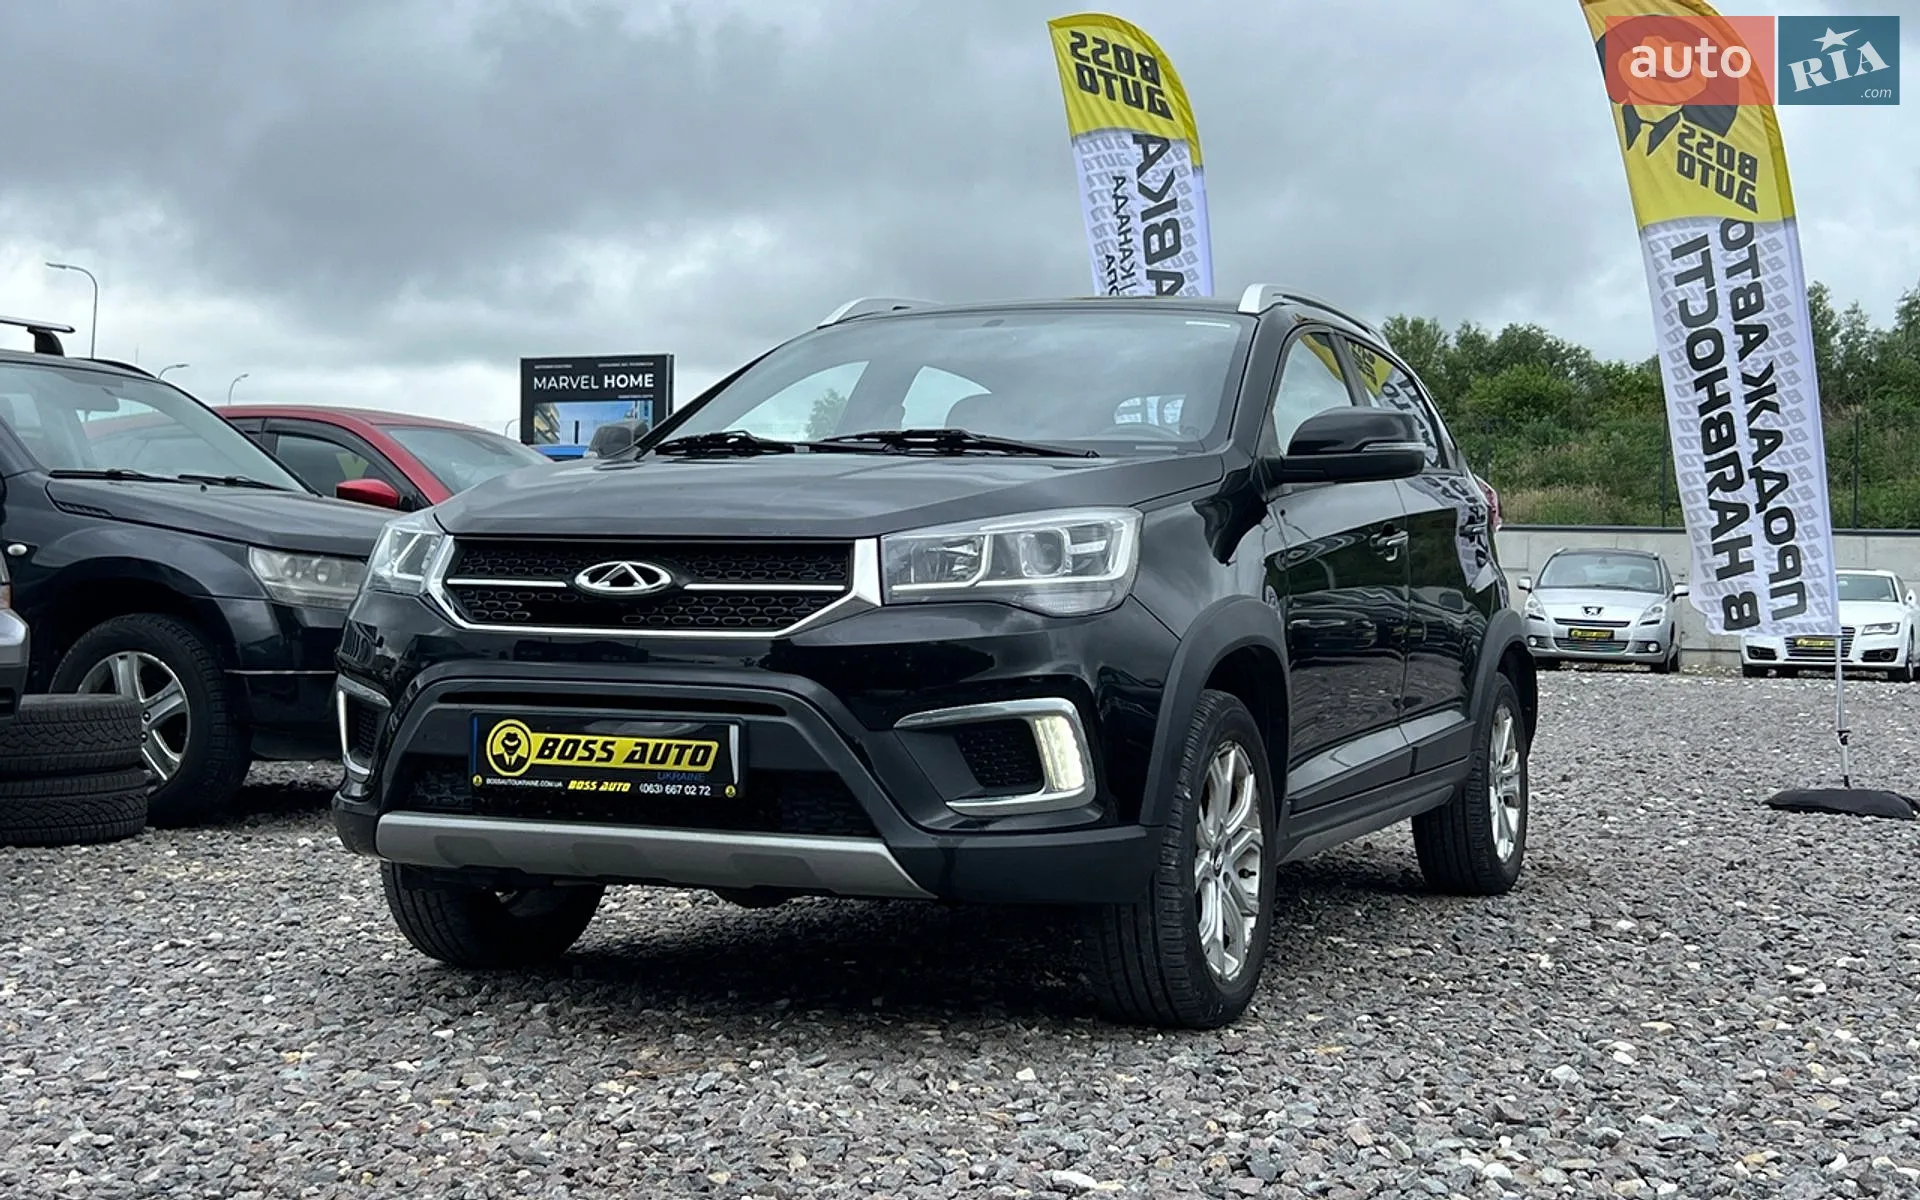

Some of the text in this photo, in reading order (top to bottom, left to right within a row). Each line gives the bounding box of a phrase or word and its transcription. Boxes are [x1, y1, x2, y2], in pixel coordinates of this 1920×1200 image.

[533, 373, 654, 390] MARVEL HOME
[536, 737, 714, 767] BOSS AUTO
[567, 780, 631, 792] BOSS AUTO
[665, 784, 682, 795] 667
[684, 785, 697, 795] 02
[698, 786, 711, 796] 72
